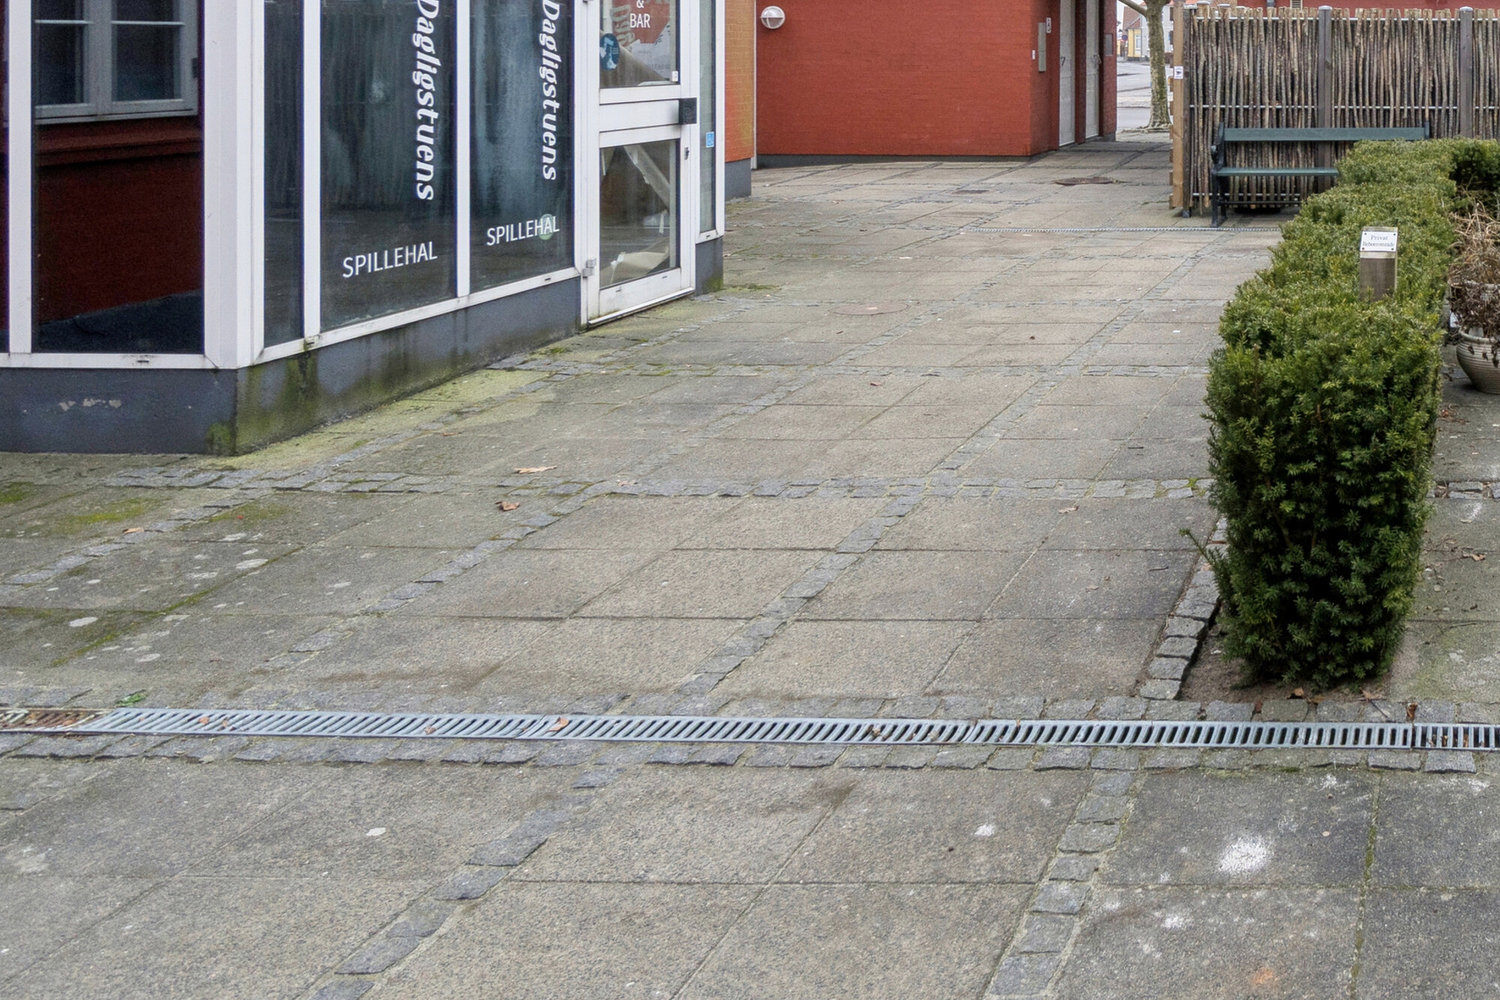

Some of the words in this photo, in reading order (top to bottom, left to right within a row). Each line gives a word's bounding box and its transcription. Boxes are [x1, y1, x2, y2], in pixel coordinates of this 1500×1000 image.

[629, 13, 651, 28] BAR
[486, 214, 560, 246] SPILLEHAL
[342, 241, 438, 278] SPILLEHAL
